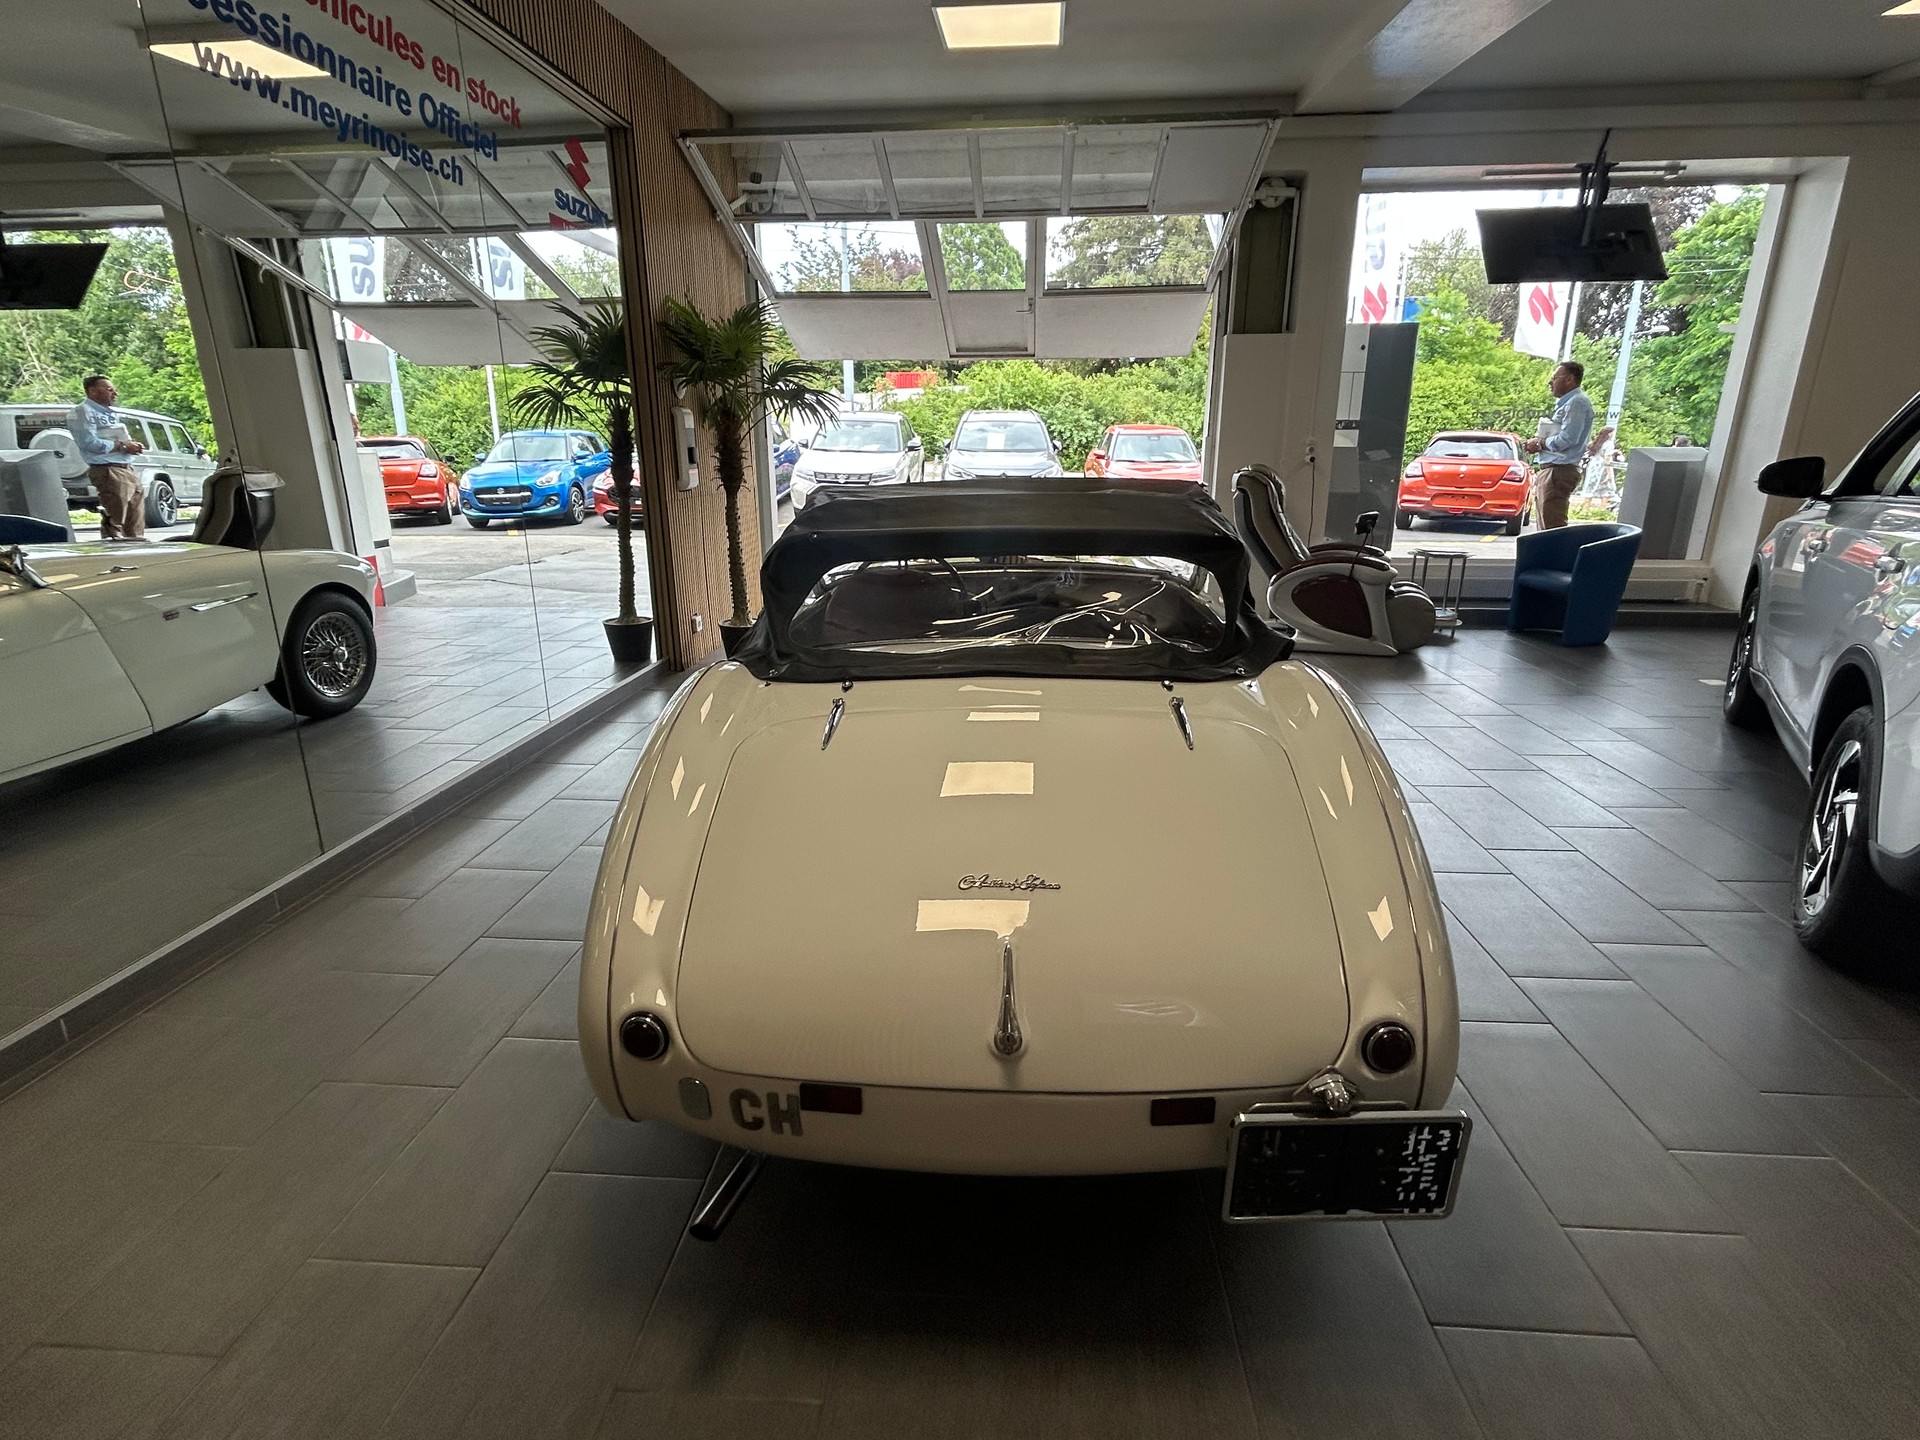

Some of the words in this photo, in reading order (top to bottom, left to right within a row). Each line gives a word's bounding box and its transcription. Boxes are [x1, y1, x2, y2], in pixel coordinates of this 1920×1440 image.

[188, 0, 412, 117] essionnaire
[419, 92, 500, 162] Officiel
[192, 42, 464, 187] www.meyrinoise.ch
[306, 0, 425, 70] icules
[432, 56, 461, 92] en
[466, 76, 522, 129] stock
[729, 1088, 803, 1137] CH
